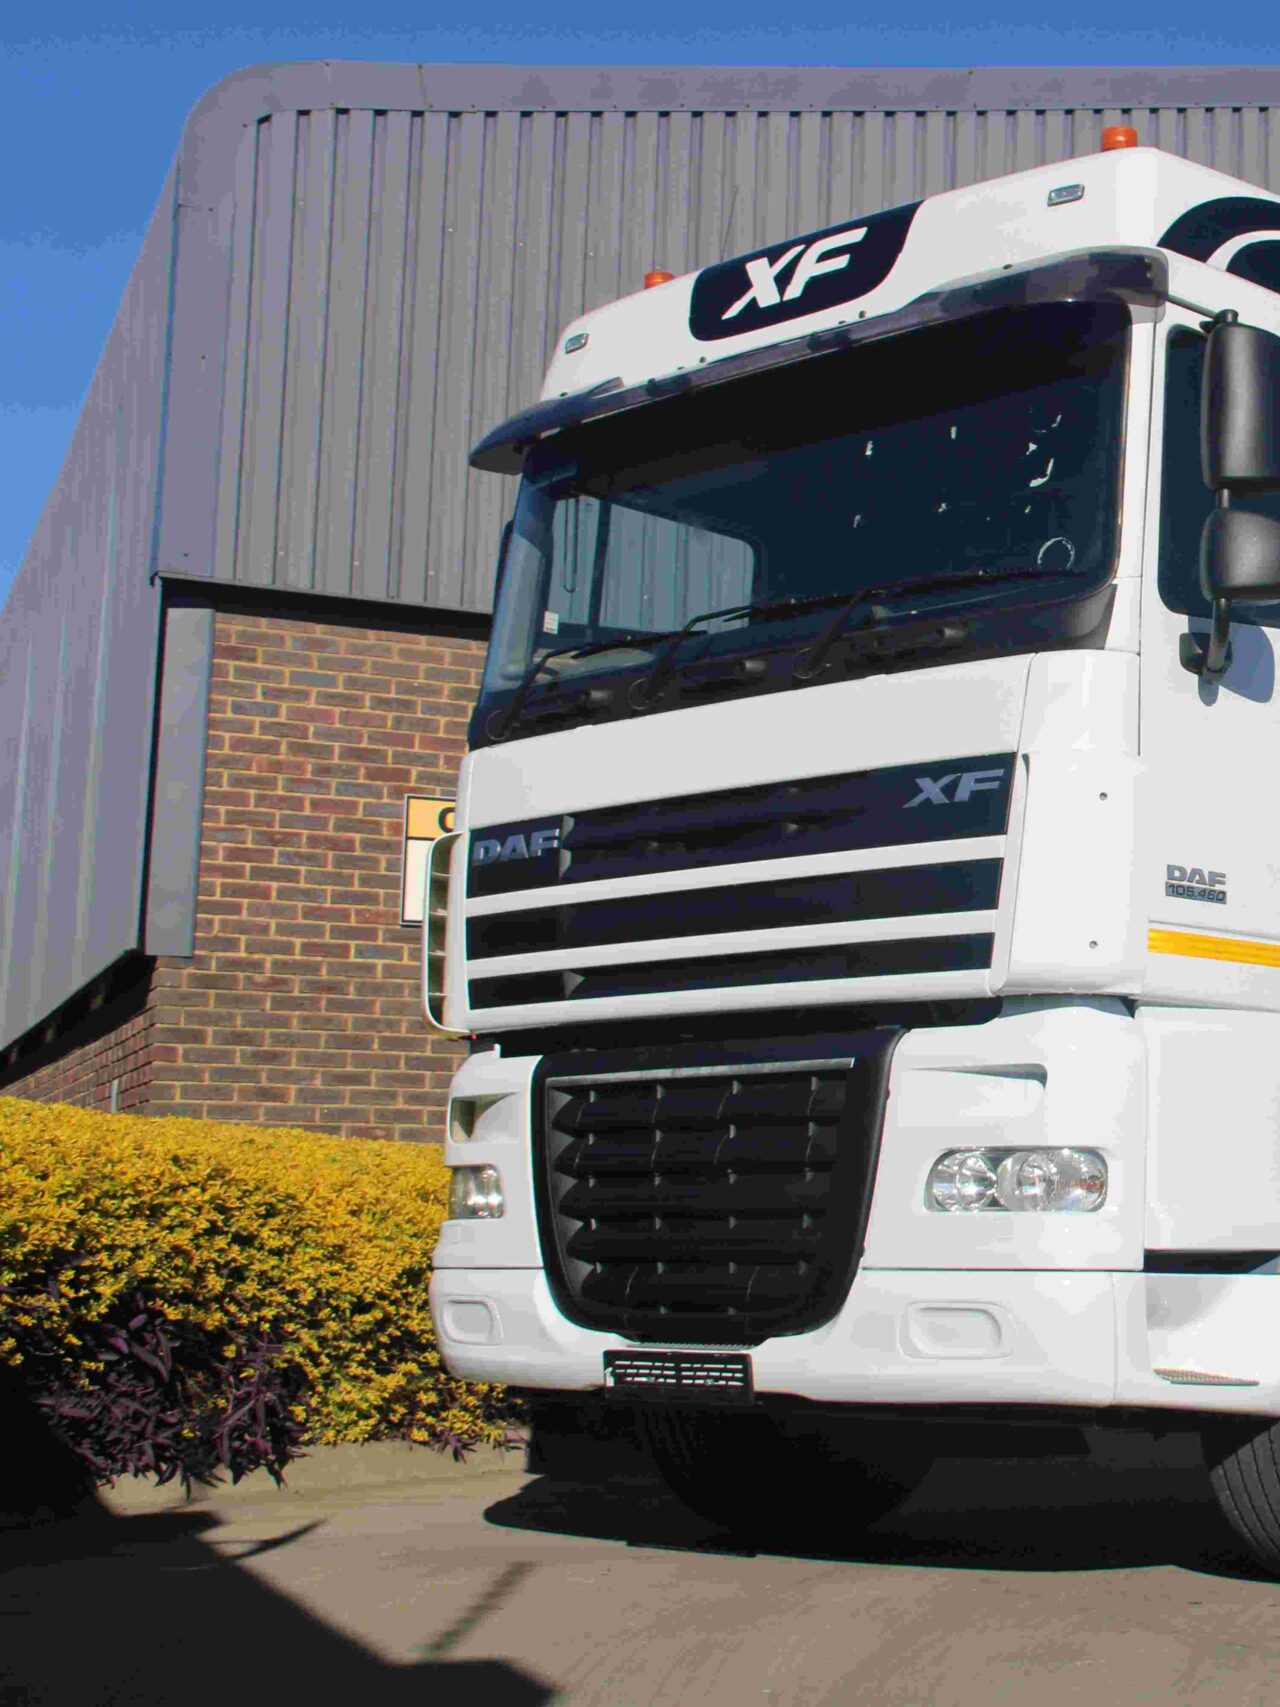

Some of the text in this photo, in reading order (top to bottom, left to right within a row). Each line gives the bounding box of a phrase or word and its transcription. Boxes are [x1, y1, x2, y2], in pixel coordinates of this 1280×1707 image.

[721, 226, 868, 320] XF
[902, 768, 1004, 808] XF
[472, 829, 560, 866] DAF
[1167, 864, 1226, 887] DAF
